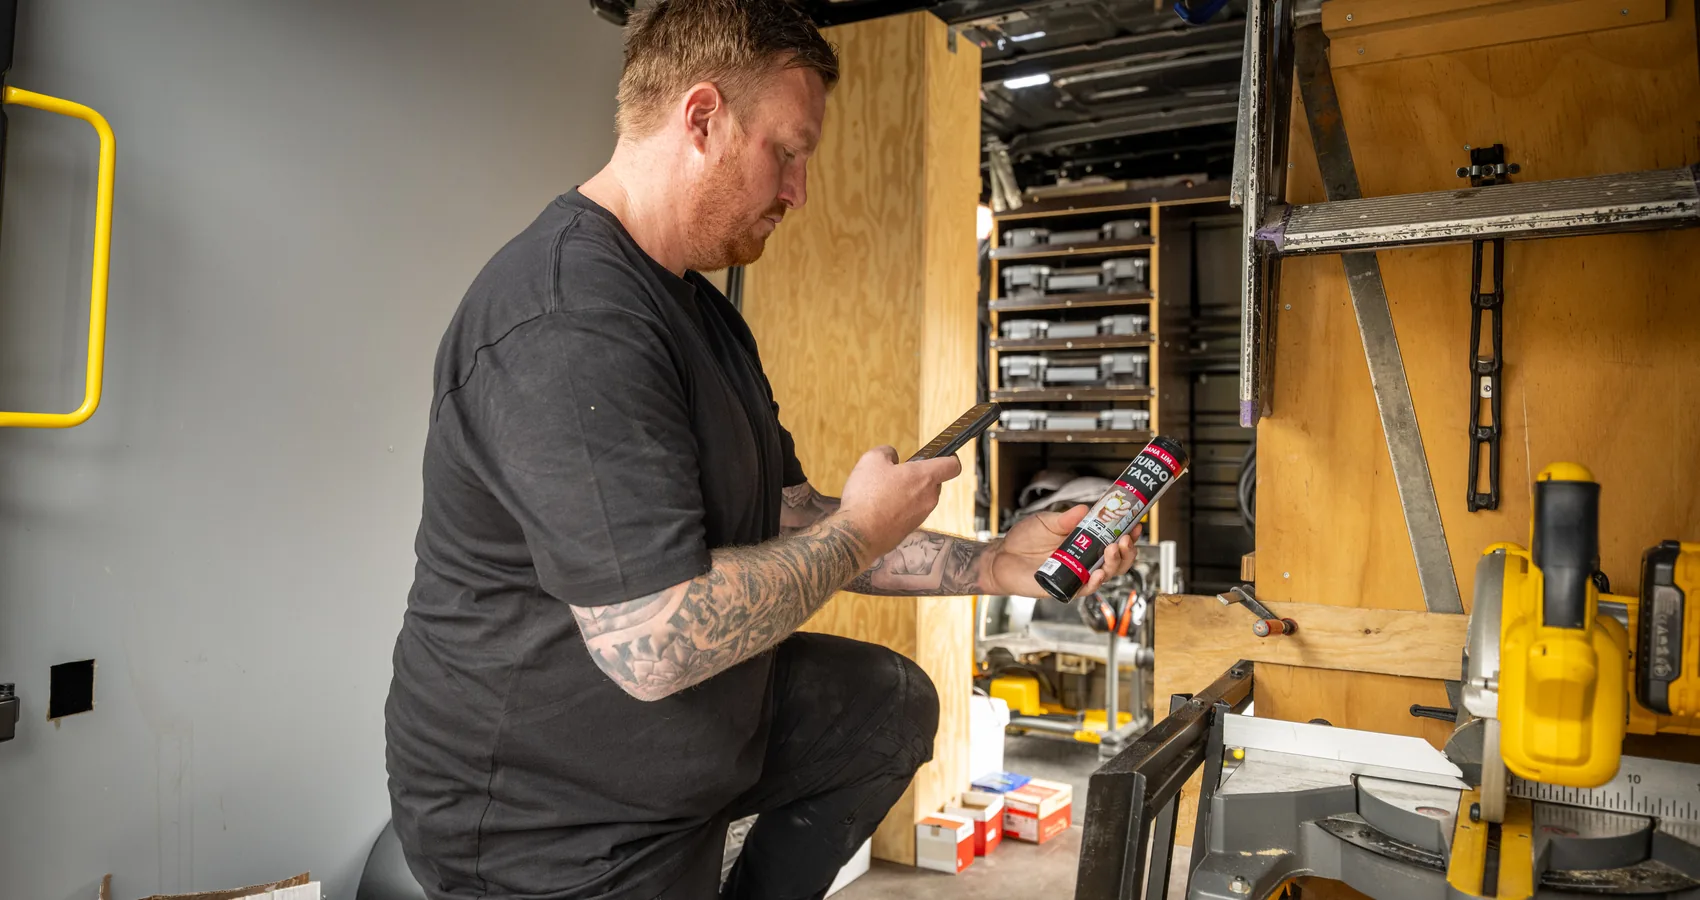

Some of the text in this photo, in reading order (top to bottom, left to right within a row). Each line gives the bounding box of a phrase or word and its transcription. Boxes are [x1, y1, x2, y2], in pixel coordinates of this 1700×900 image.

[1160, 454, 1172, 464] LIM
[1134, 455, 1168, 482] TURBO
[1128, 466, 1158, 492] TACK
[1125, 483, 1137, 494] 291
[1076, 534, 1090, 550] DL
[1627, 774, 1641, 784] 10
